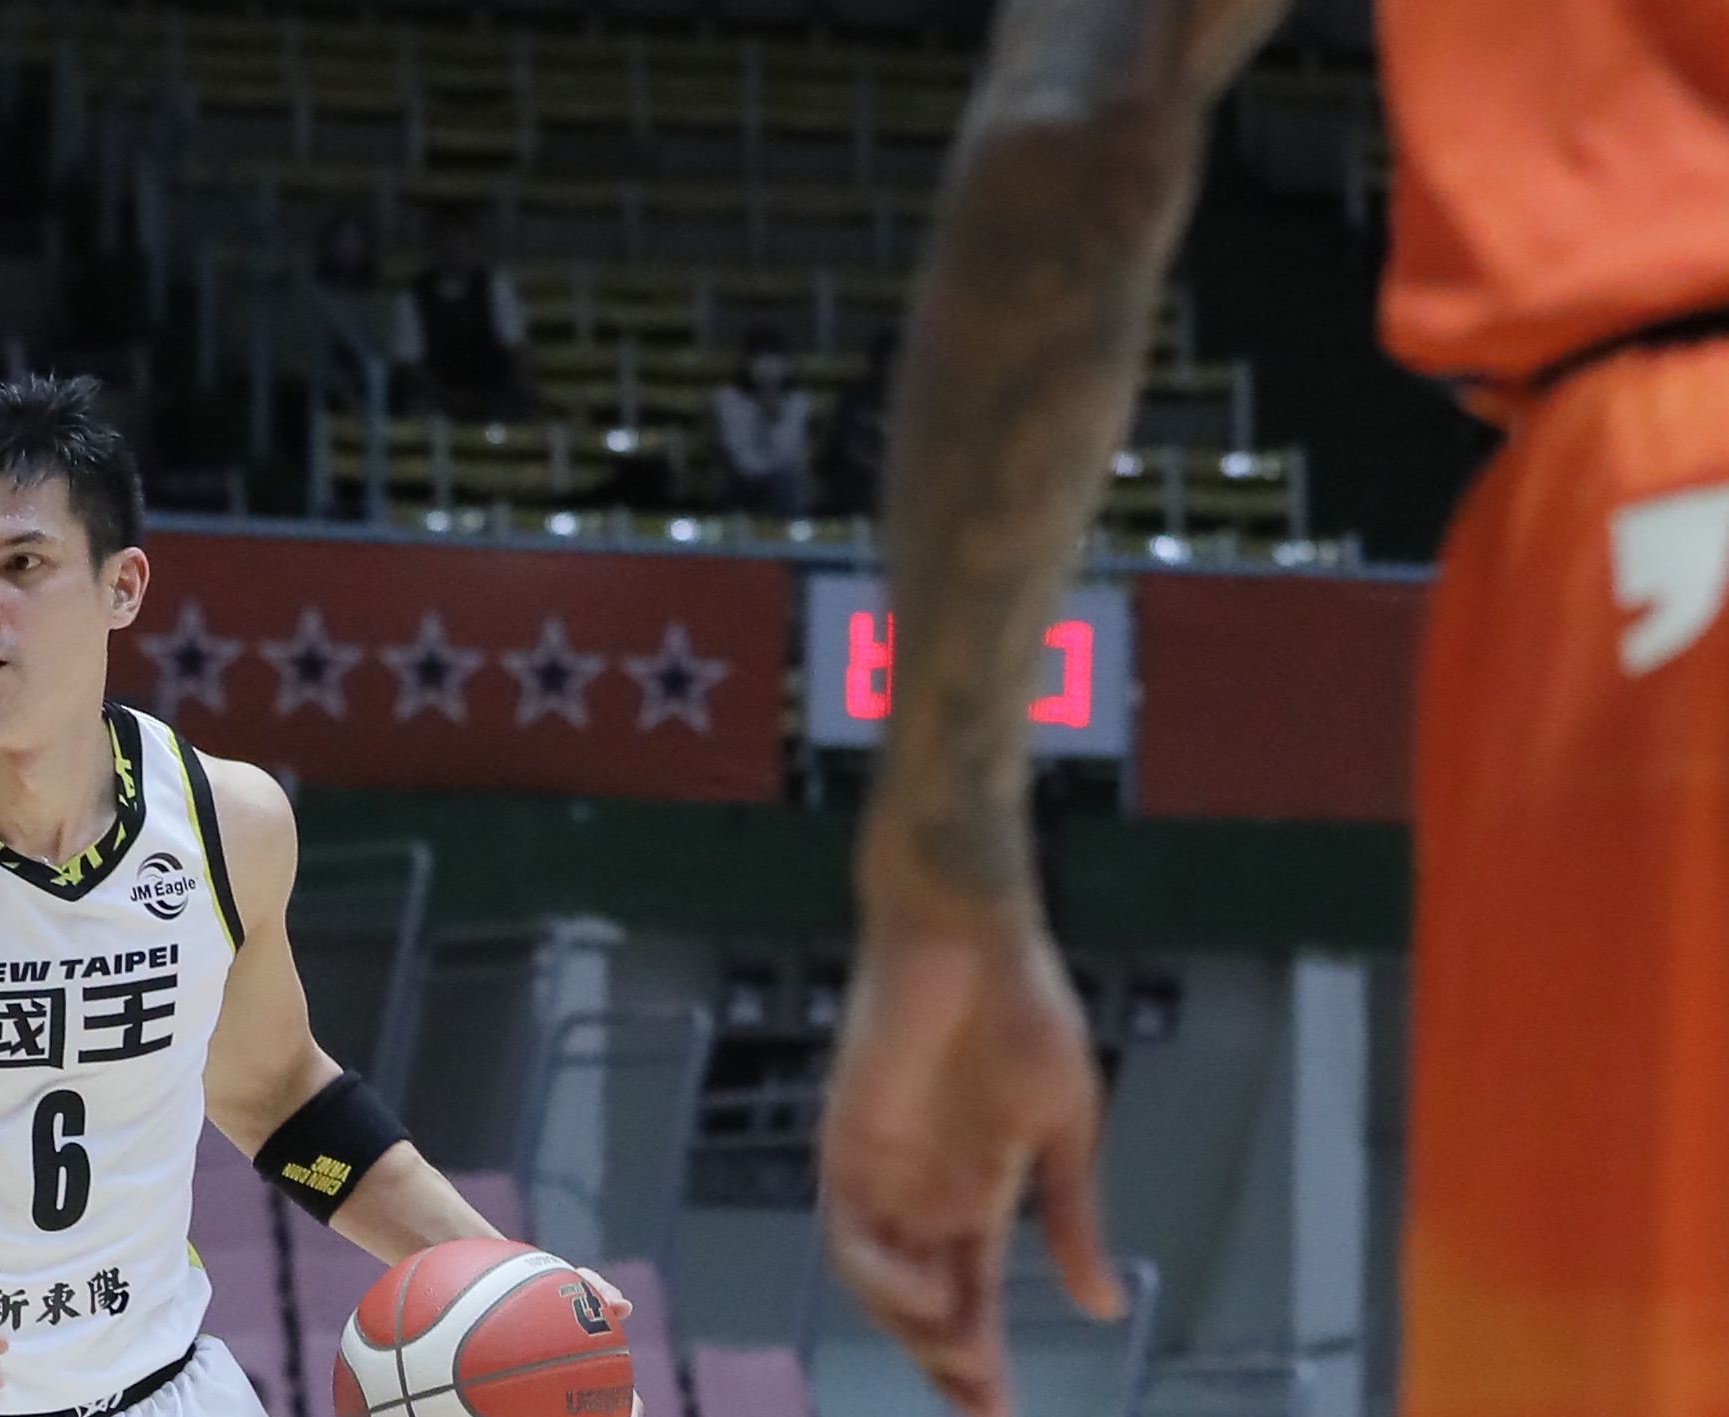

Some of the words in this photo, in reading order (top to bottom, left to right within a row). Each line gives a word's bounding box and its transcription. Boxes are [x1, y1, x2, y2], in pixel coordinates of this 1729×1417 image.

[130, 884, 152, 902] JM
[154, 876, 196, 896] Eagle
[60, 944, 179, 980] TAIPEI
[32, 1089, 91, 1232] 6
